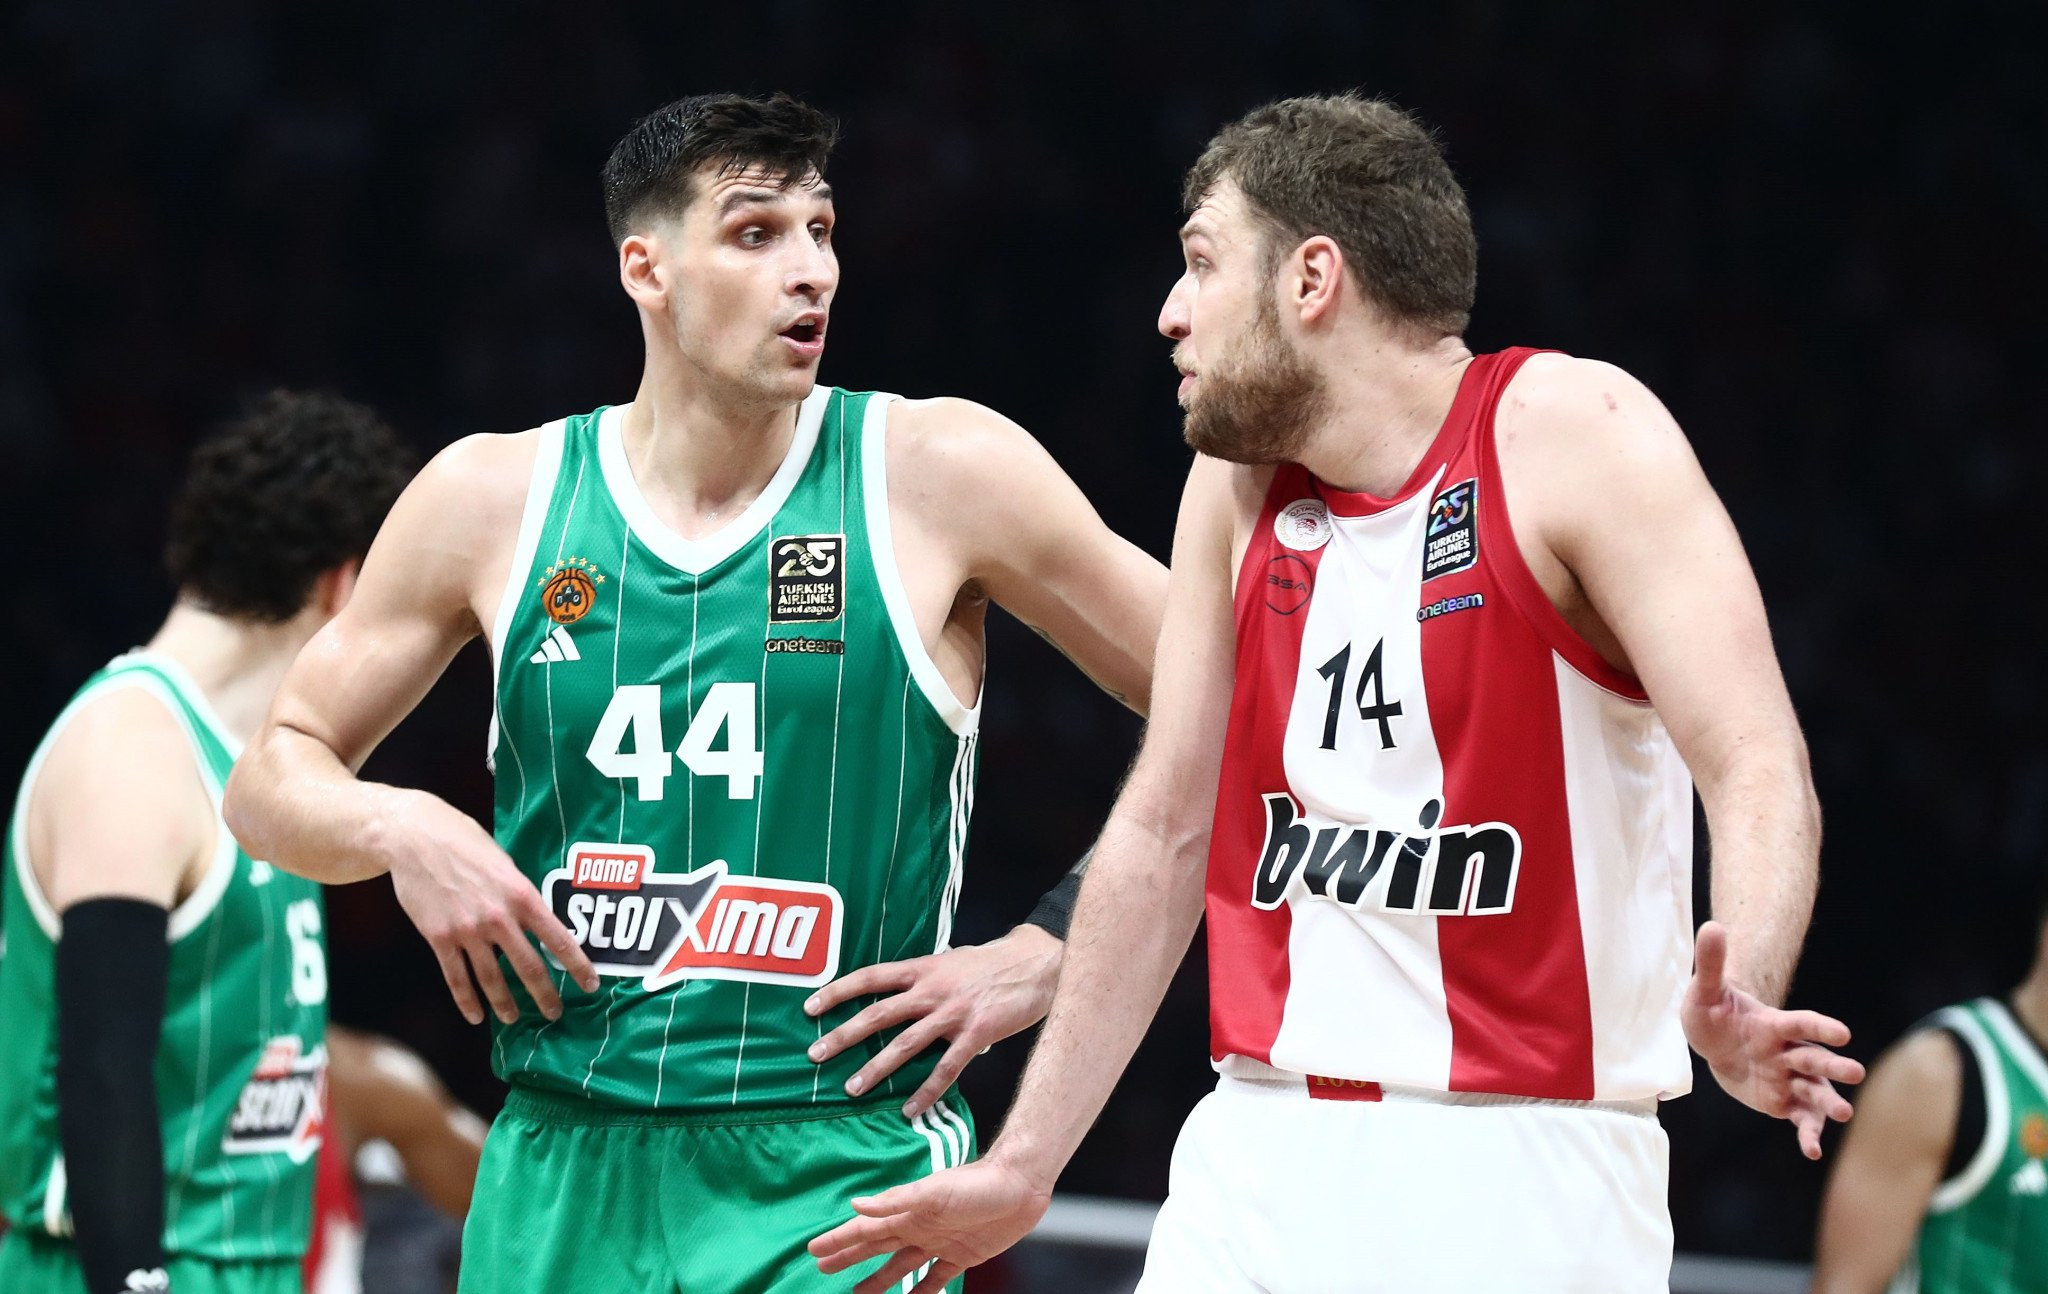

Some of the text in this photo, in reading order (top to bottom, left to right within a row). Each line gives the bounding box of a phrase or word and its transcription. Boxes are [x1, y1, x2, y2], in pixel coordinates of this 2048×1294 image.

[1429, 487, 1470, 537] 25
[1427, 538, 1471, 563] AIRLINES
[1428, 528, 1470, 553] TURKISH
[778, 541, 836, 577] 25
[1426, 550, 1471, 572] EuroLeague
[778, 593, 835, 605] AIRLINES
[779, 583, 835, 595] TURKISH
[777, 604, 836, 616] EuroLeague
[1417, 593, 1483, 621] oneteam
[765, 637, 844, 654] oneteam
[1315, 635, 1404, 751] 14
[585, 682, 764, 802] 44
[1253, 794, 1519, 913] bwin
[576, 856, 640, 885] pame
[285, 898, 328, 1006] 6
